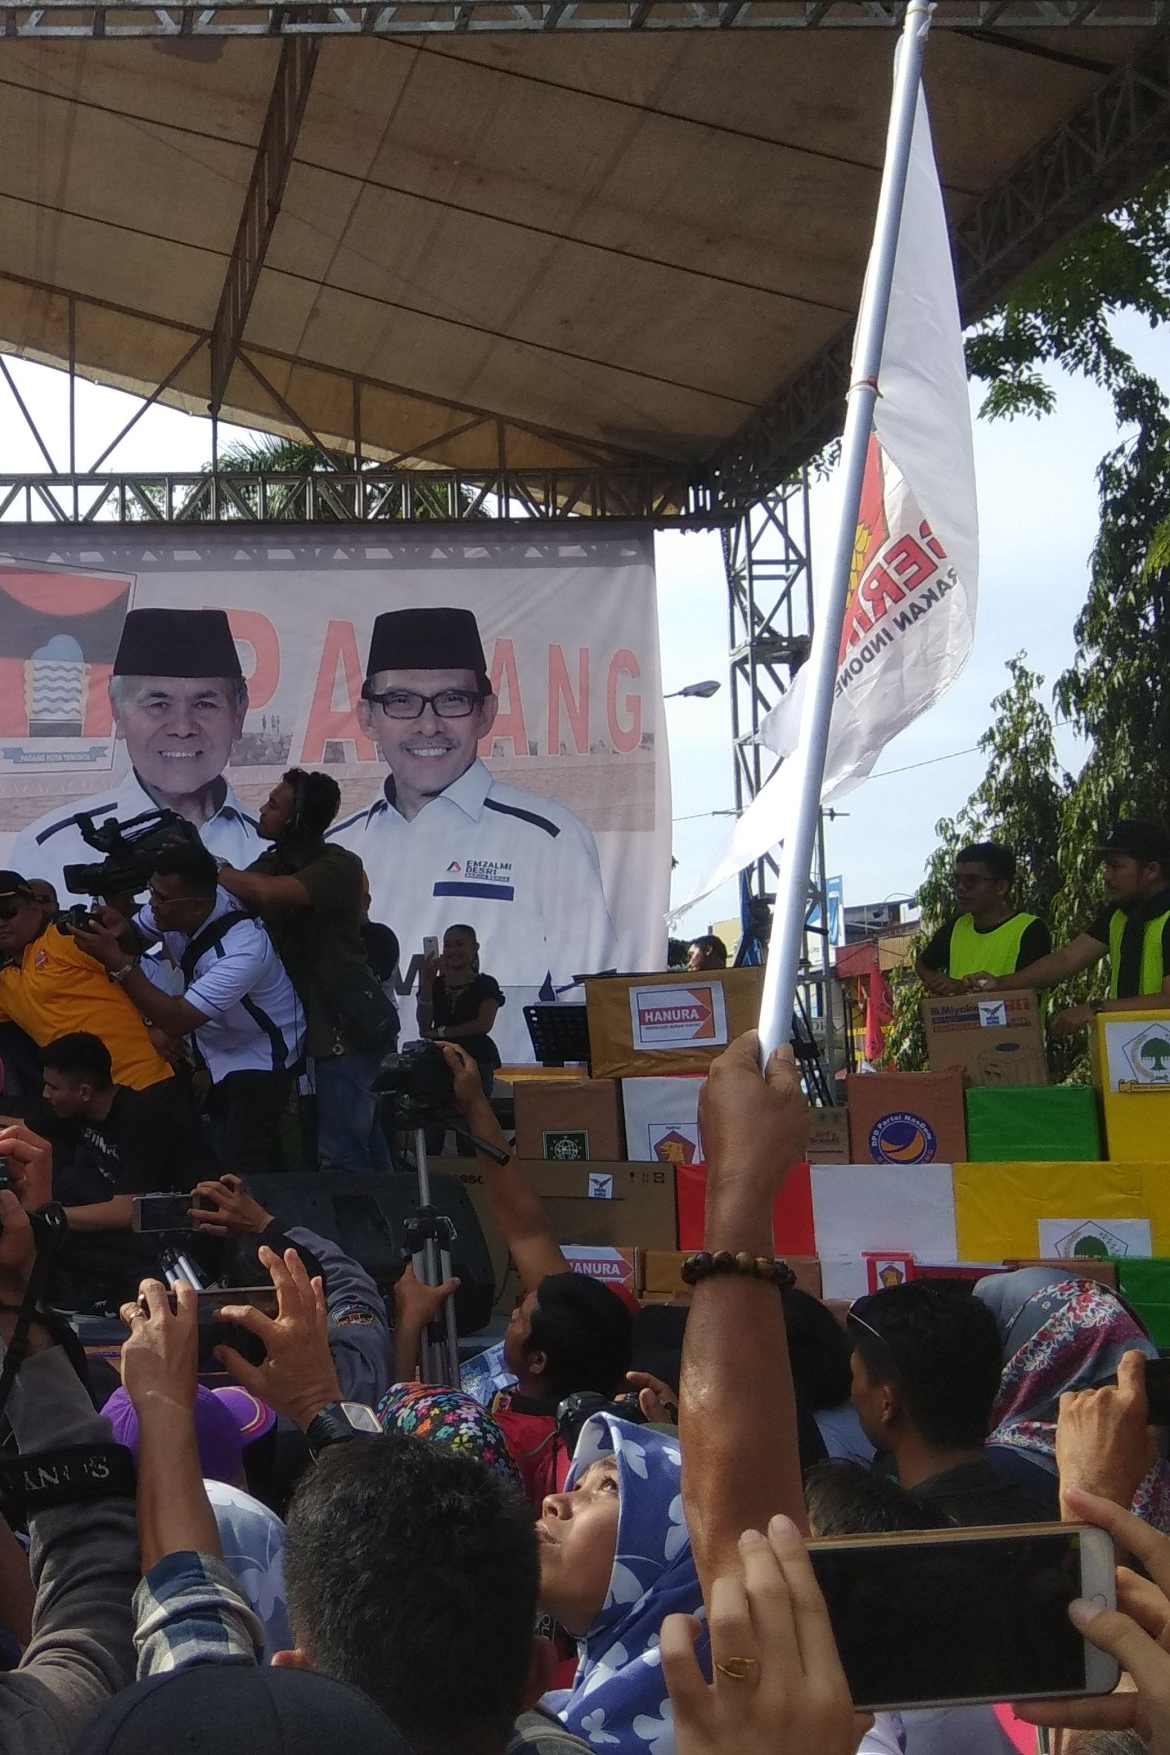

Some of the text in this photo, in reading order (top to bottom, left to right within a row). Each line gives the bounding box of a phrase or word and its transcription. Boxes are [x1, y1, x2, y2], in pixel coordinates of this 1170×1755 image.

[466, 860, 512, 870] EMZALMI
[466, 867, 497, 875] DESRI
[644, 1008, 700, 1023] HANURA
[871, 1129, 880, 1147] DPD
[904, 1114, 932, 1140] NasDem
